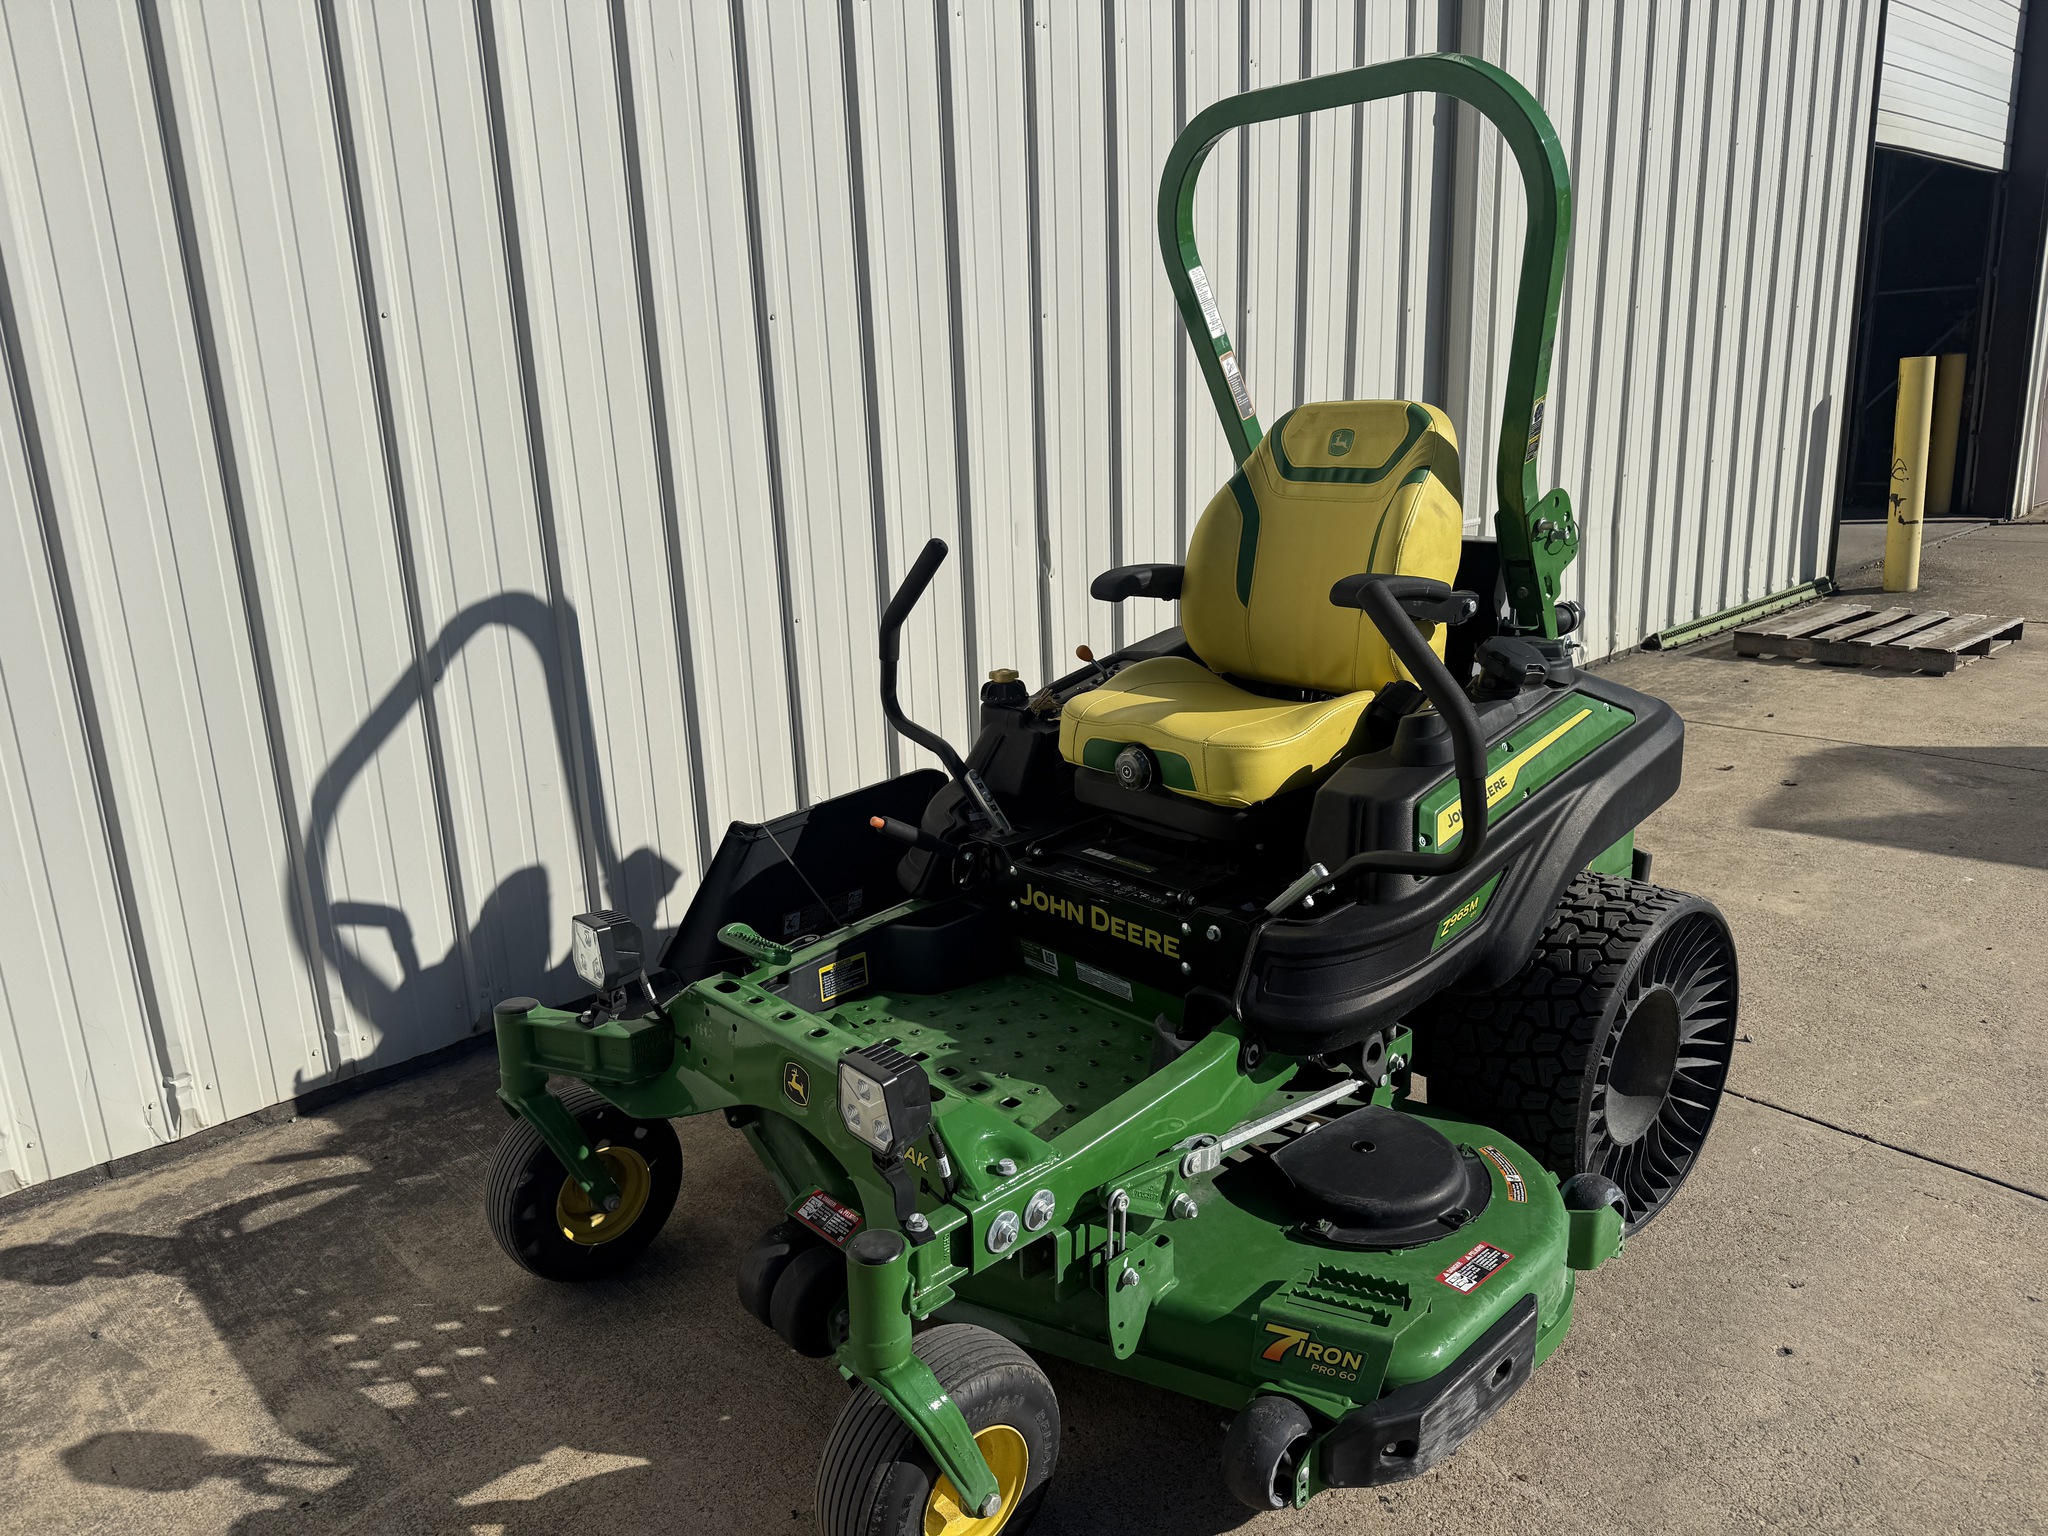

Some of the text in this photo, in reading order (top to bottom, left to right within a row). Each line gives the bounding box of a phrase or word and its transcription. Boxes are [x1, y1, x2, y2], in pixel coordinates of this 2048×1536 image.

[1019, 883, 1084, 926] JOHN
[1090, 904, 1180, 960] DEERE
[1440, 896, 1479, 938] Z965M
[1310, 1363, 1357, 1382] PRO 60
